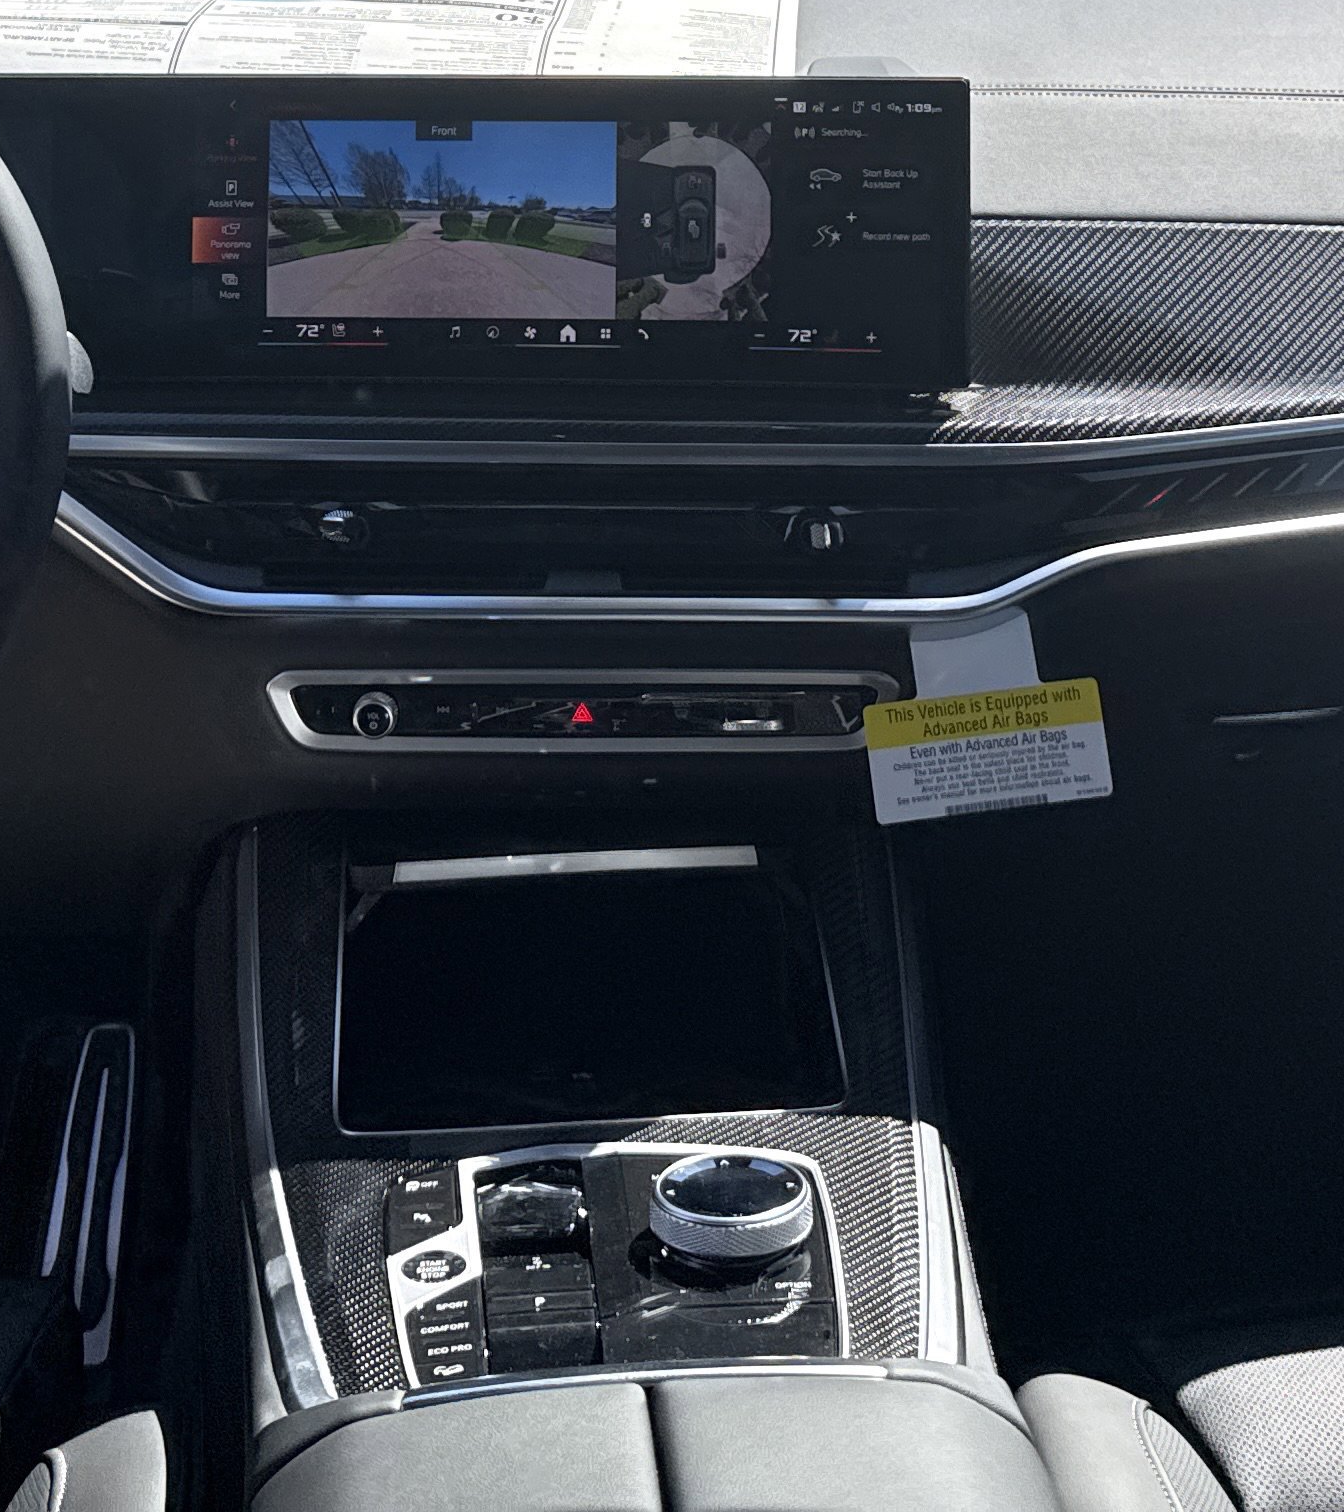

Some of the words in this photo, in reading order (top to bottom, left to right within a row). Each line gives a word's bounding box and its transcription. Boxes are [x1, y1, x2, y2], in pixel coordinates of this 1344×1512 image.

[431, 125, 457, 137] Front
[862, 169, 882, 178] Start
[884, 169, 904, 178] Back
[906, 169, 919, 180] Up
[862, 180, 901, 189] Assistant
[208, 199, 234, 208] Assist
[235, 199, 254, 208] View
[862, 232, 891, 241] Record
[911, 232, 931, 243] path
[210, 240, 251, 249] Panorama
[219, 291, 240, 300] More
[885, 707, 915, 724] This
[917, 700, 966, 720] Vehicle
[970, 698, 982, 713] is
[986, 689, 1049, 713] Equipped
[1051, 686, 1081, 703] with
[367, 712, 379, 720] VOL
[923, 716, 988, 738] Advanced
[993, 712, 1010, 730] Air
[1015, 710, 1049, 728] Bags
[910, 746, 937, 760] Even
[939, 741, 963, 756] with
[965, 734, 1019, 753] Advanced
[1022, 732, 1037, 746] Air
[1040, 729, 1068, 744] Bags
[420, 1180, 439, 1188] OFF
[416, 1265, 450, 1274] ENGINE
[421, 1272, 447, 1280] STOP
[775, 1281, 813, 1290] OPTION
[436, 1300, 469, 1312] SPORT
[420, 1321, 471, 1335] COMFORT
[427, 1345, 449, 1357] ECO
[450, 1342, 473, 1355] PRO
